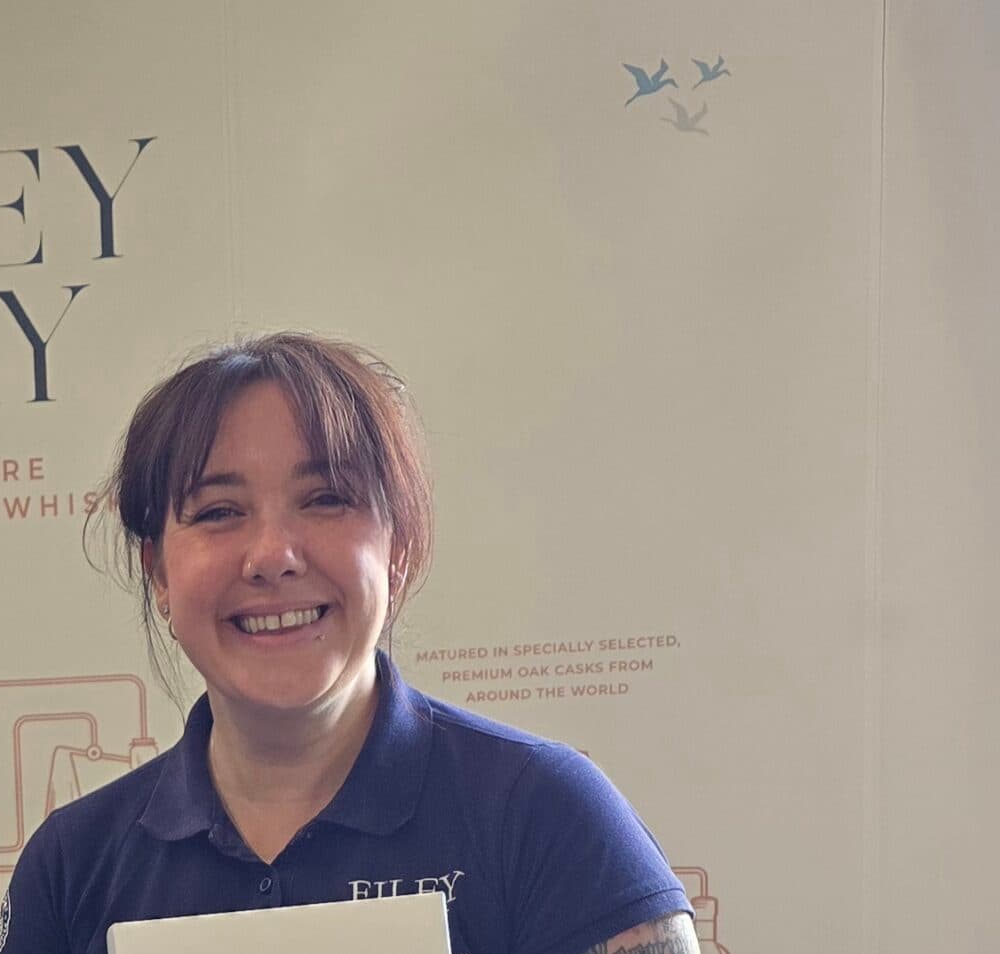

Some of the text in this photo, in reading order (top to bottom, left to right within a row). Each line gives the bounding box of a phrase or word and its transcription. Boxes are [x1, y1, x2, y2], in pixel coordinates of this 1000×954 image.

[415, 634, 681, 664] MATURED IN SPECIALLY SELECTED,
[441, 658, 654, 683] PREMIUM OAK CASKS FROM
[465, 682, 630, 704] AROUND THE WORLD
